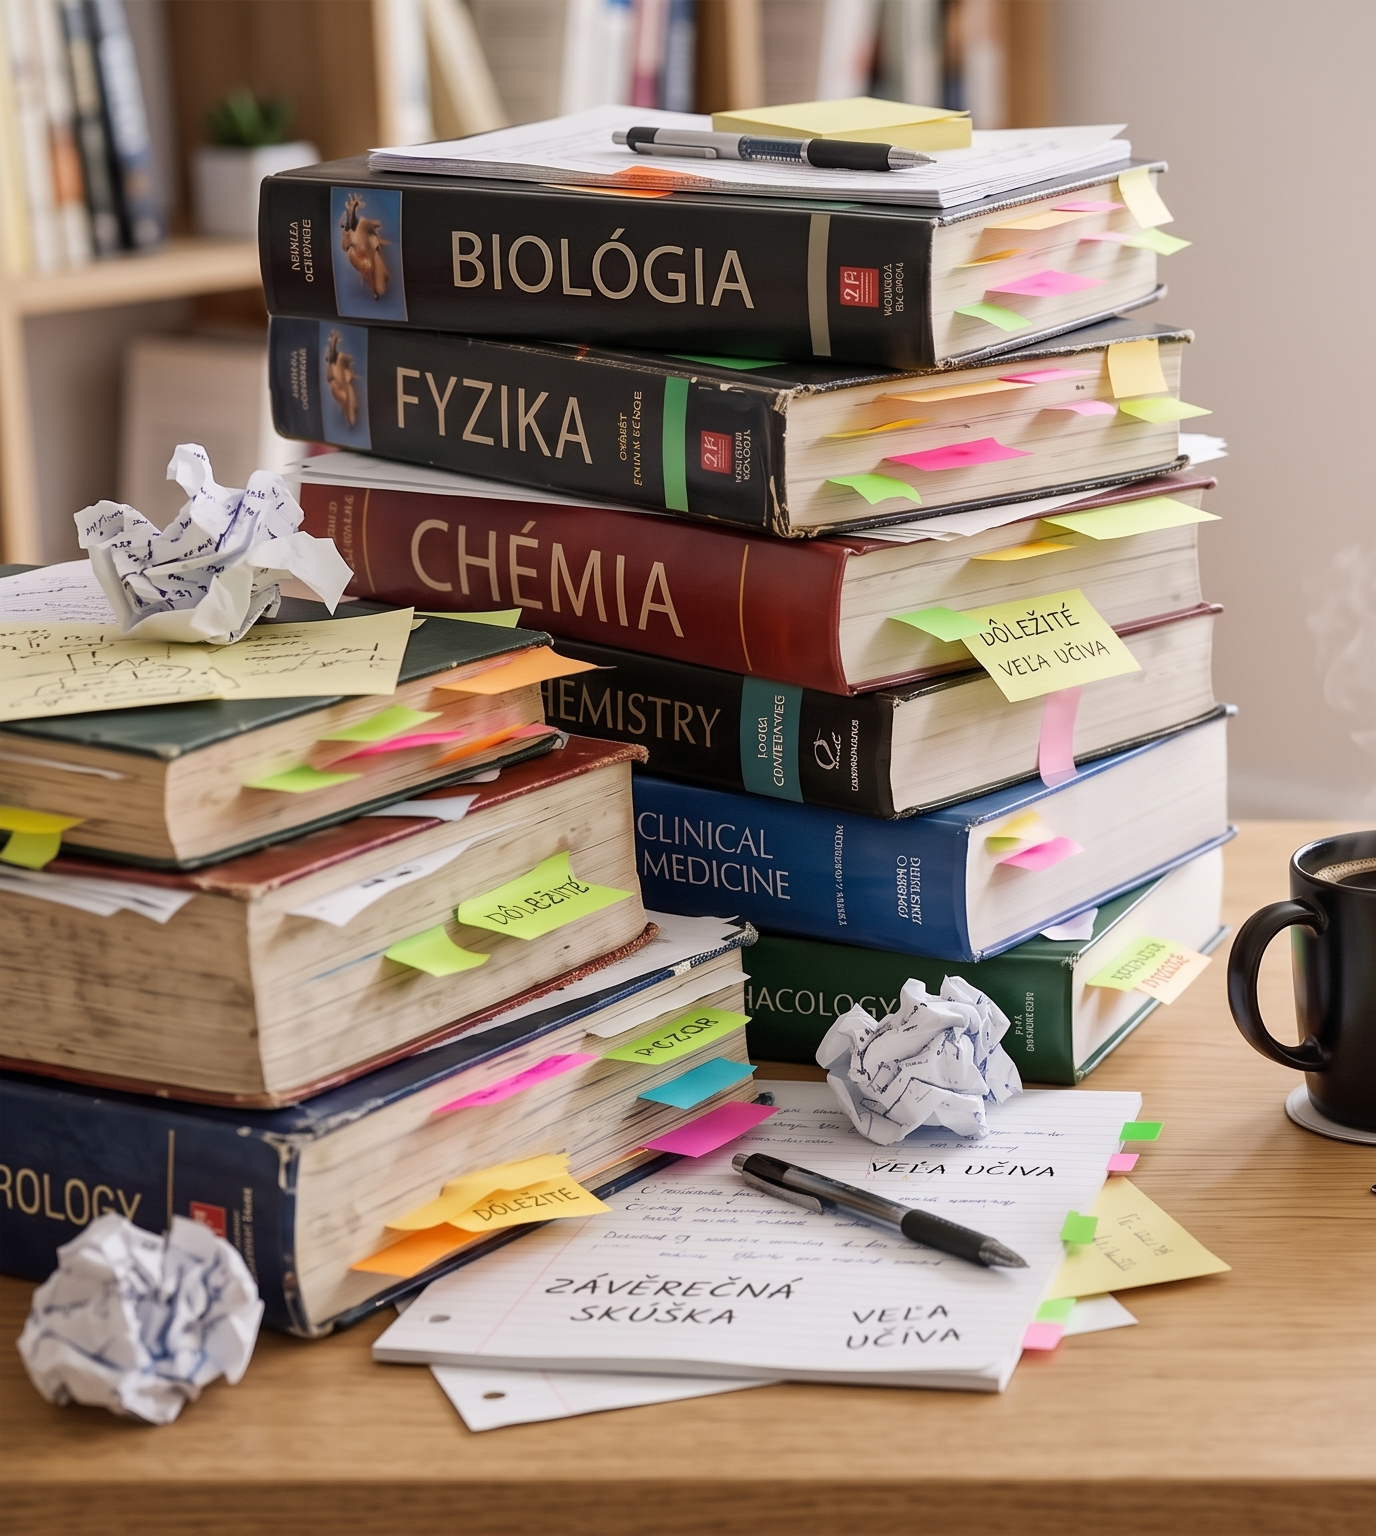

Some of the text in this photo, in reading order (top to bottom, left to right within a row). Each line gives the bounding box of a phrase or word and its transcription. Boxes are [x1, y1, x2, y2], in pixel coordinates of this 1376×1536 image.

[451, 228, 755, 309] BIOLÓGIA
[394, 366, 593, 465] FYZIKA
[410, 519, 684, 638] CHÉMIA
[979, 602, 1081, 647] DÔLEŽITÉ
[998, 639, 1111, 677] VEĽA UČIVA
[637, 811, 774, 860] CLINICAL
[643, 851, 791, 900] MEDICINE
[870, 1160, 1056, 1178] VEĽA UČIVA
[569, 1301, 737, 1325] SKÚŠKA
[851, 1304, 951, 1324] VEĽA
